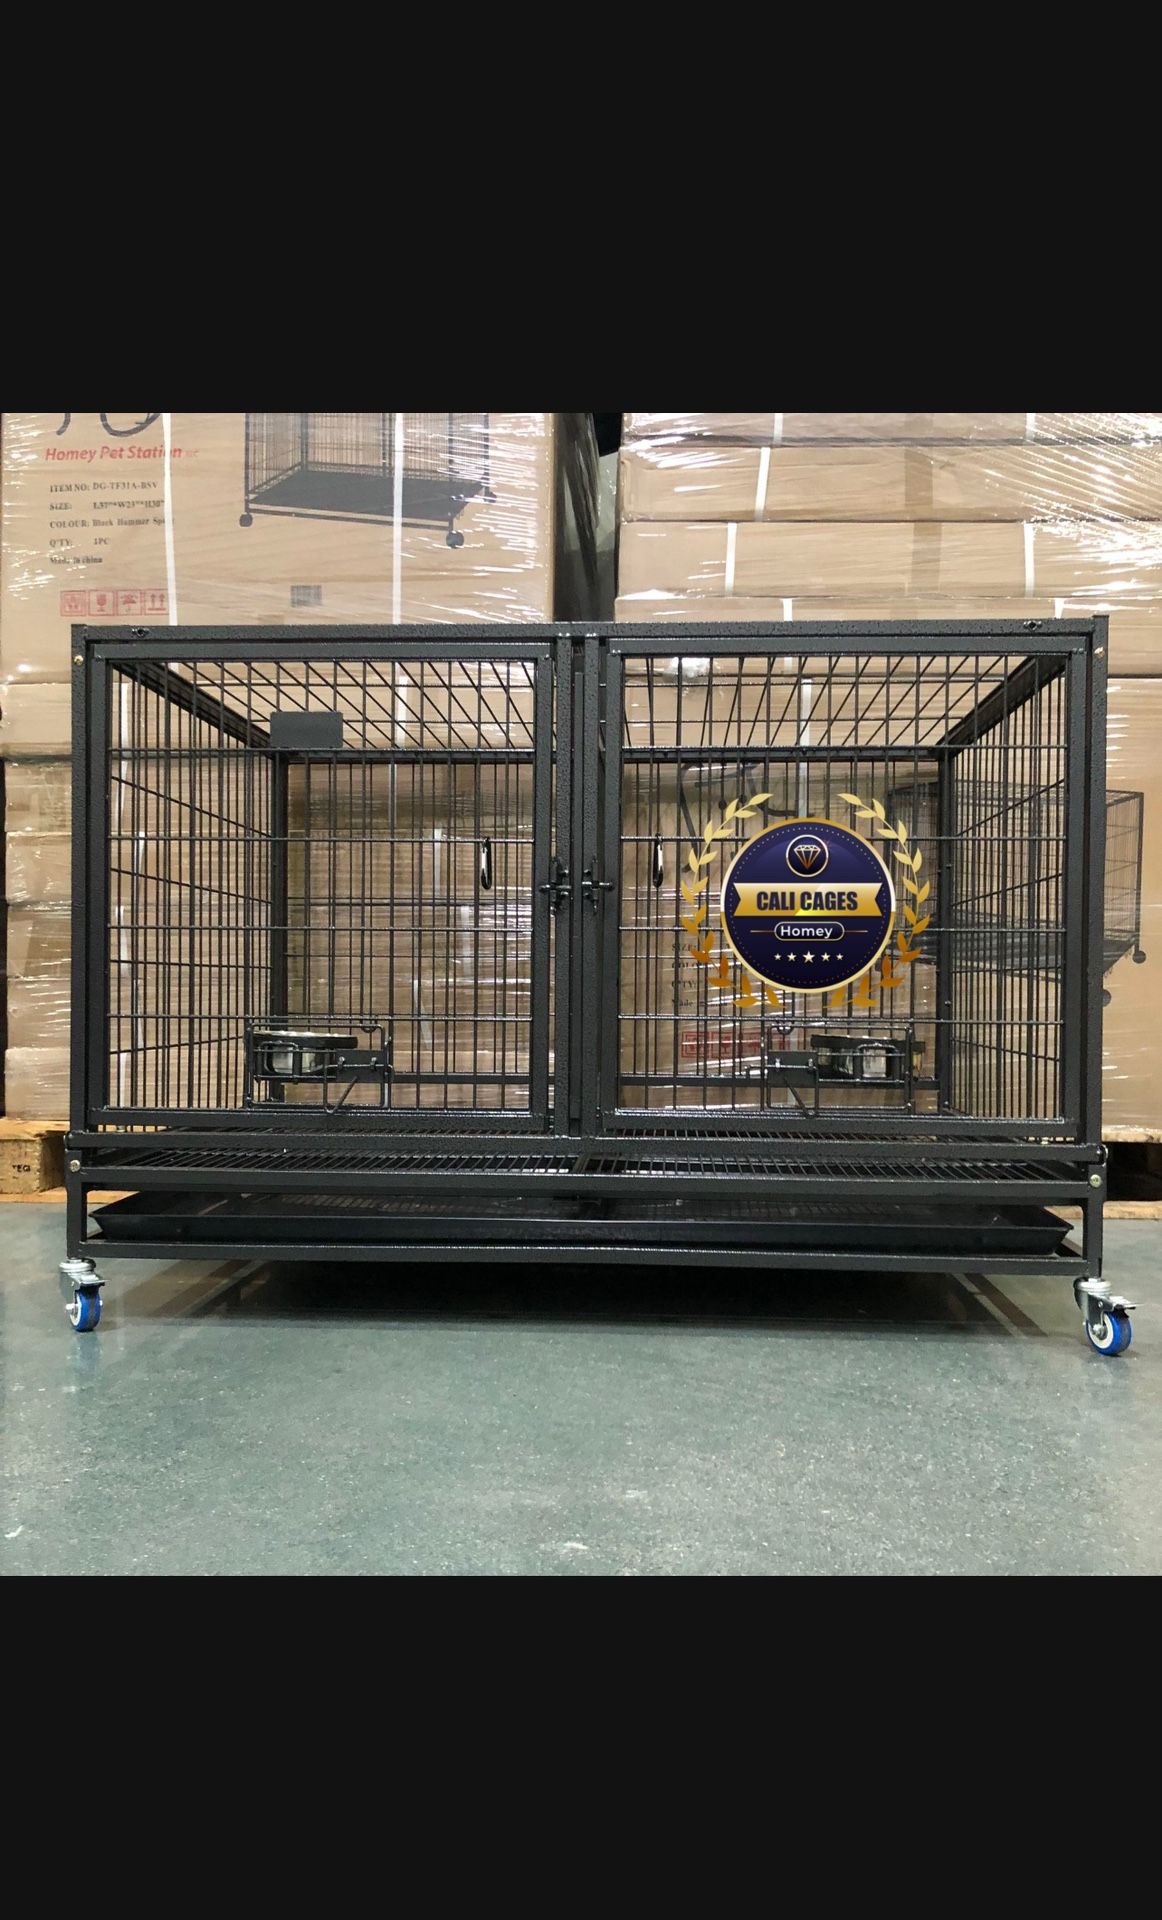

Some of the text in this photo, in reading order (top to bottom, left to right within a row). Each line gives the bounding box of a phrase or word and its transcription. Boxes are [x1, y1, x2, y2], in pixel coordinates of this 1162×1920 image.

[45, 447, 96, 463] Homey
[100, 446, 124, 459] Pet
[127, 445, 182, 459] Statin
[49, 520, 90, 529] COLOUR:
[94, 537, 110, 546] 1PC
